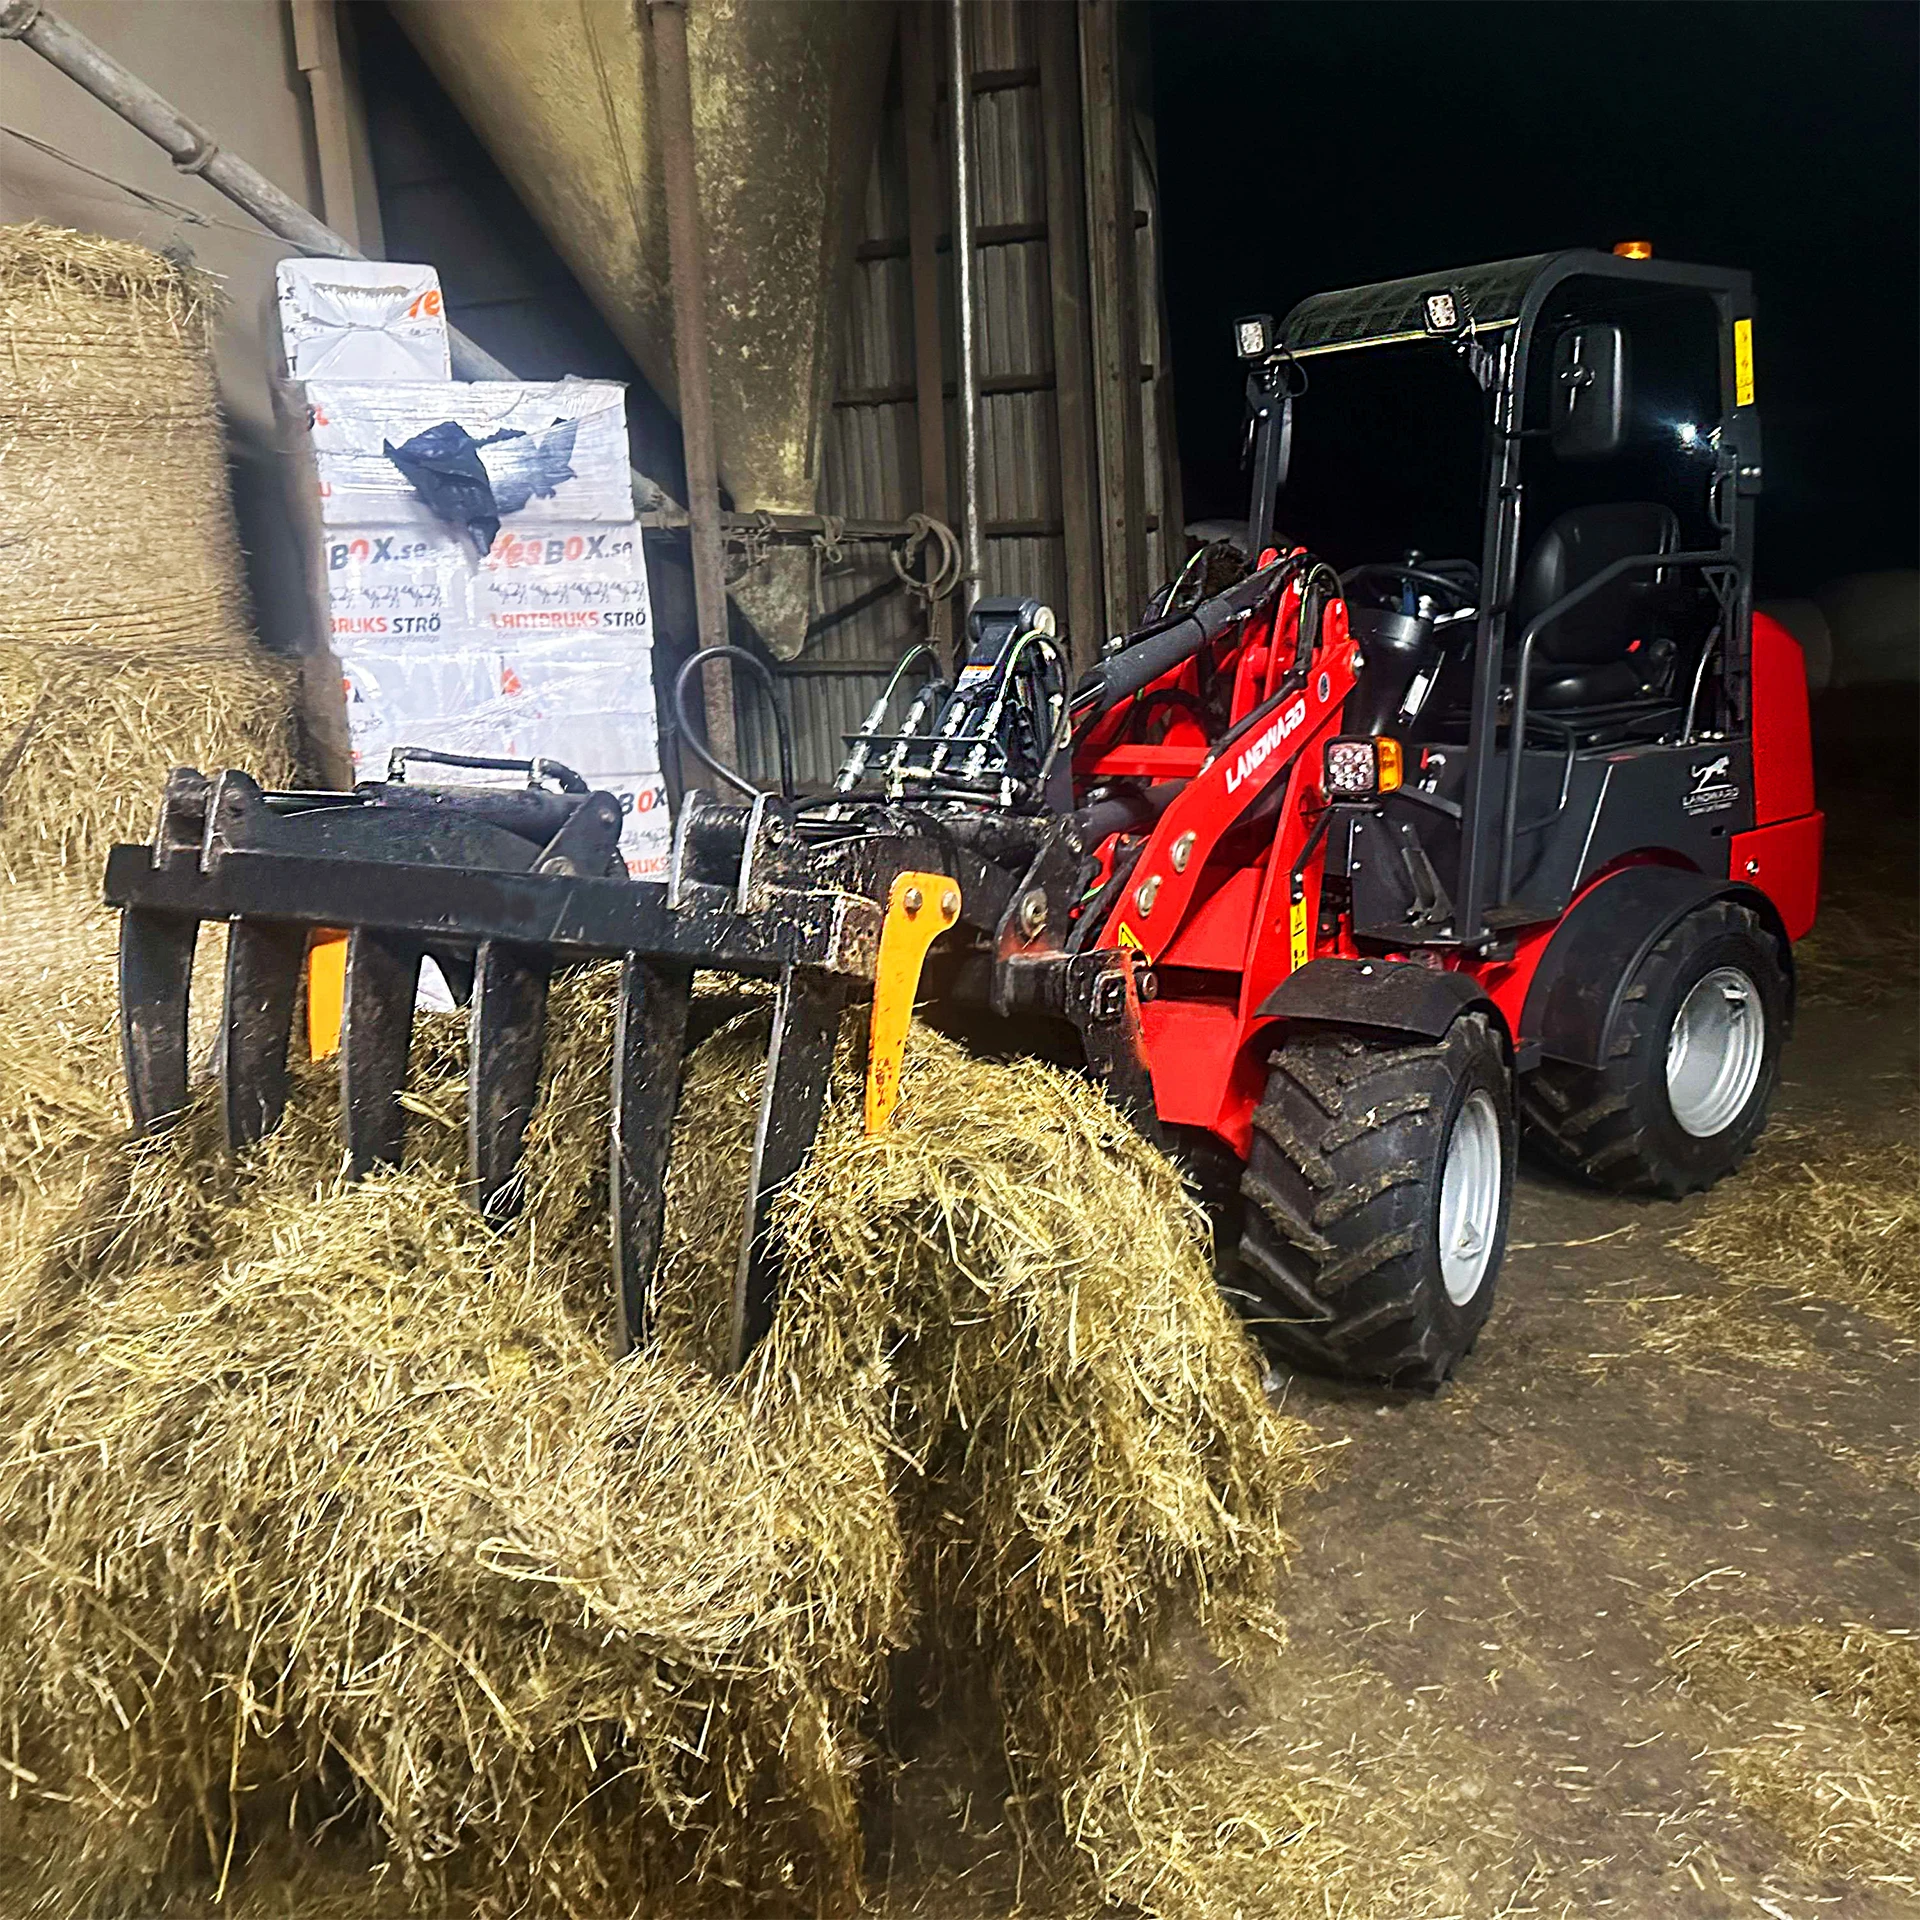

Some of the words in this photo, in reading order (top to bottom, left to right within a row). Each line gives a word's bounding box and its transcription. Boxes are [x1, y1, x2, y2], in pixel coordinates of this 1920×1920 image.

[392, 613, 441, 634] STRÖ
[490, 611, 599, 629] LANTBRUKS
[602, 608, 646, 628] STRÖ
[1225, 698, 1306, 793] LANDWARD
